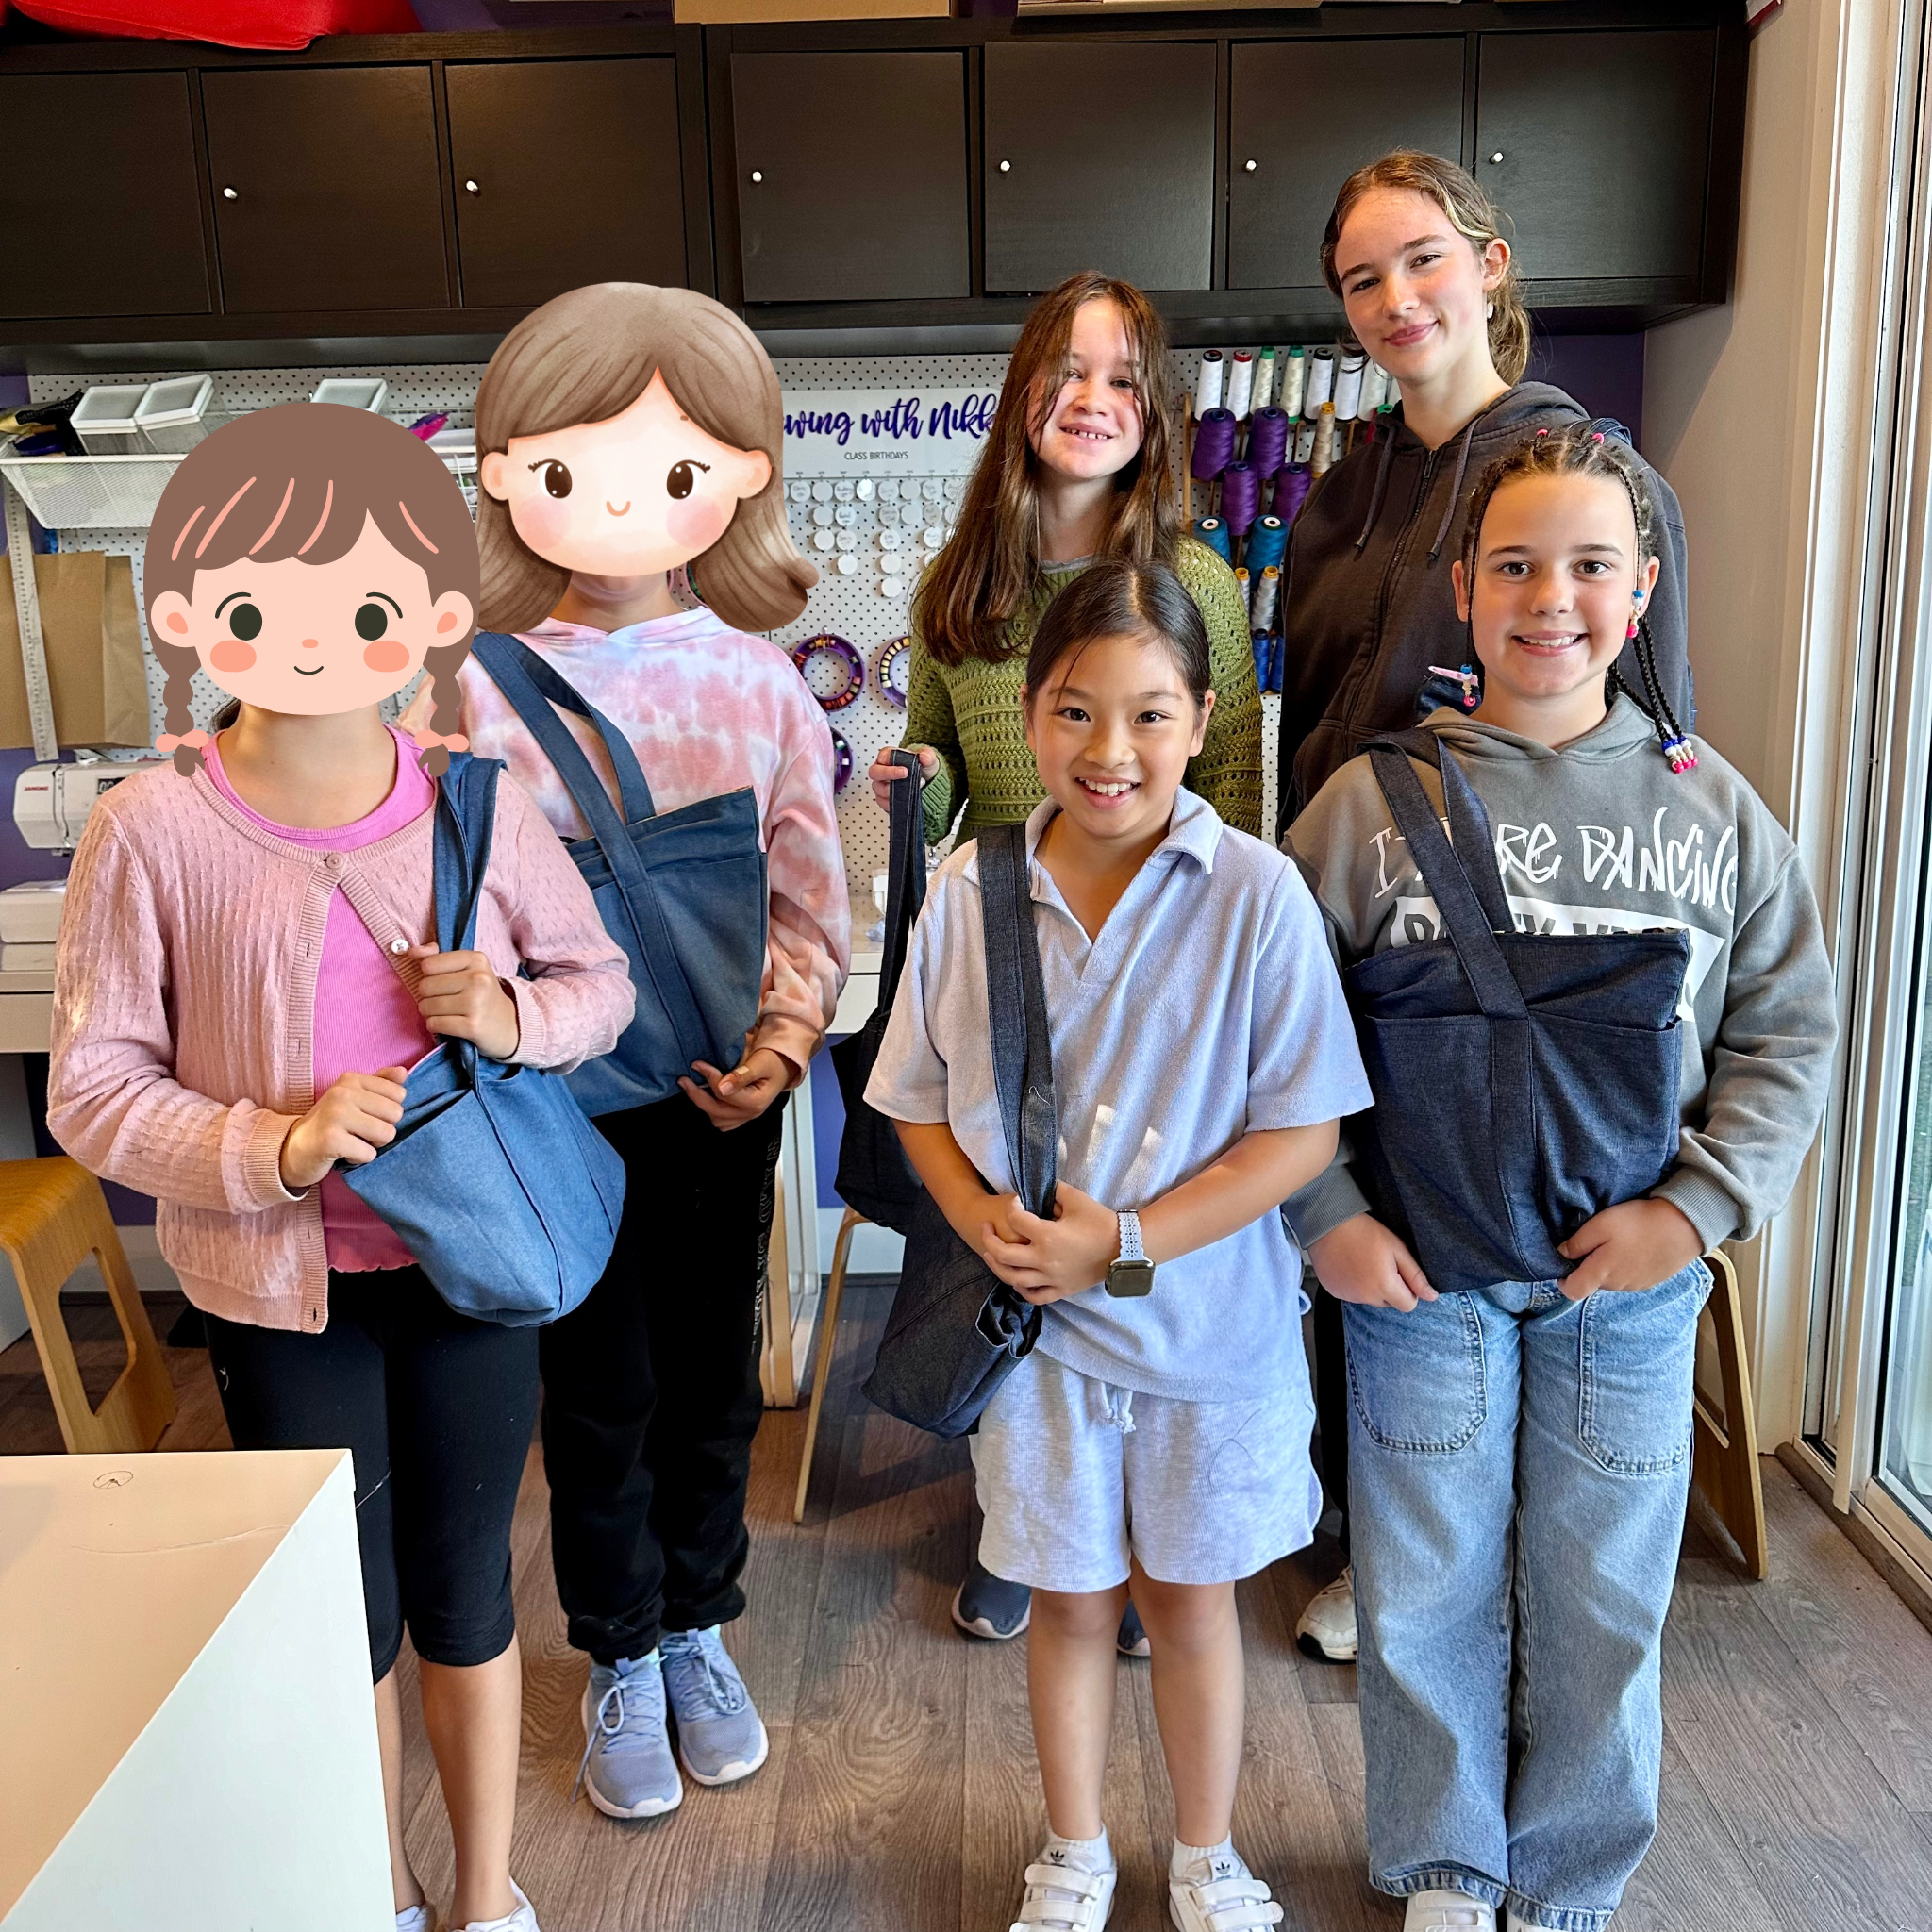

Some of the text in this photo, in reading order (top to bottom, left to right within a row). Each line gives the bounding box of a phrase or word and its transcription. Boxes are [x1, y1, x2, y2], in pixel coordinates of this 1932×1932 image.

[783, 393, 996, 446] wing with Nikk
[843, 450, 909, 461] CLASS BIRTHDAYS
